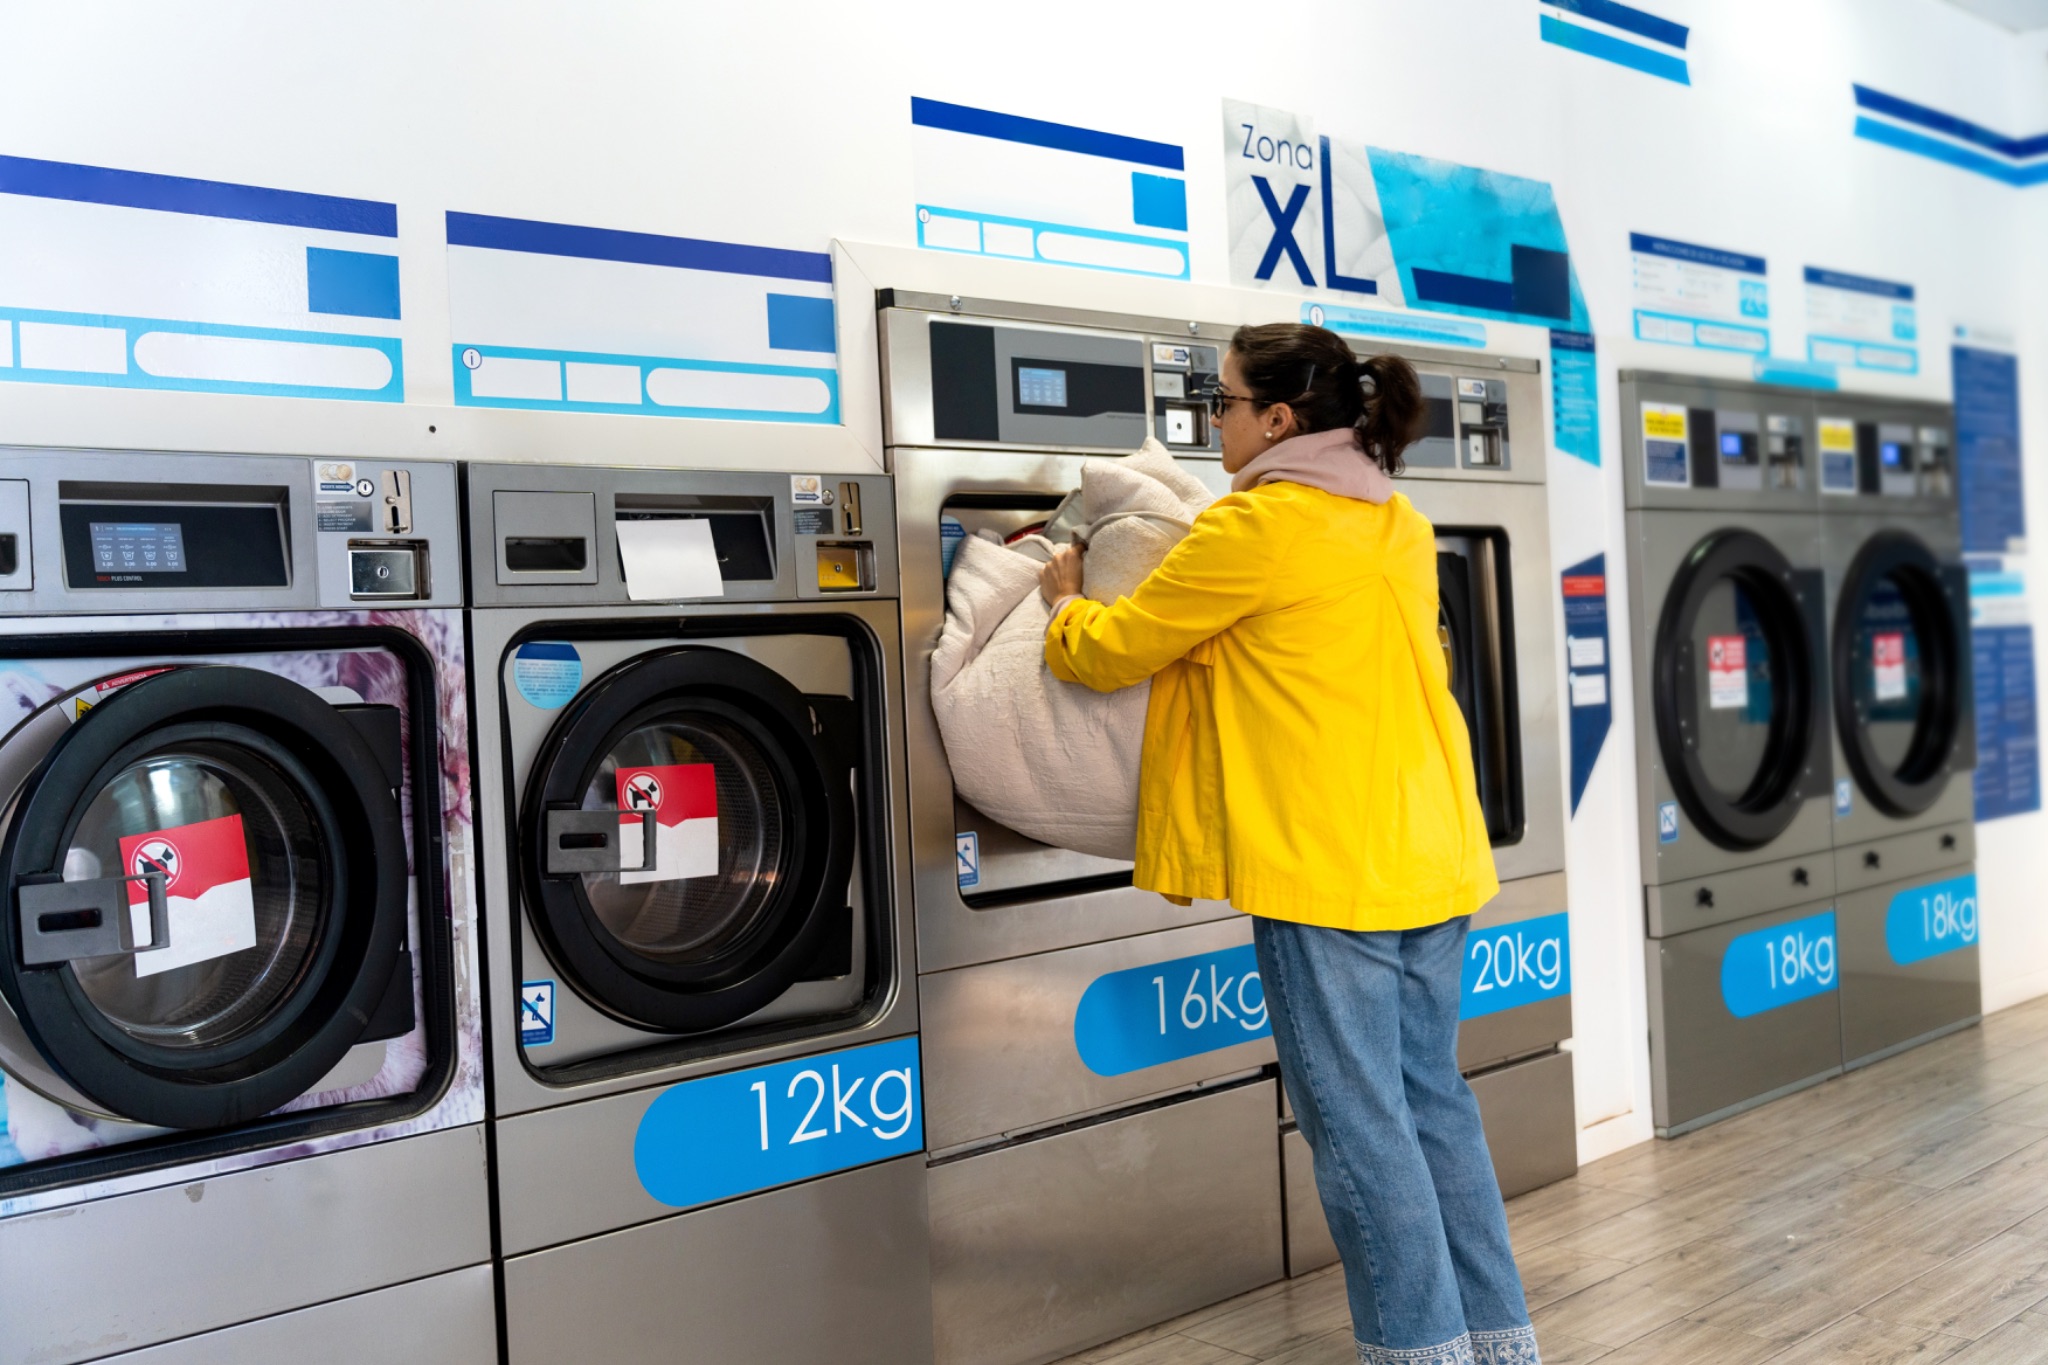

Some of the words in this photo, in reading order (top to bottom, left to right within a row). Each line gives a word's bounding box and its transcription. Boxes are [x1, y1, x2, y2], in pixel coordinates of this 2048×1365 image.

[1242, 124, 1313, 170] Zona
[1251, 134, 1378, 296] XL
[1936, 892, 1977, 942] 18kg
[1471, 932, 1561, 991] 20kg
[1766, 932, 1835, 989] 18kg
[1152, 964, 1269, 1035] 16kg
[751, 1064, 913, 1151] 12kg
